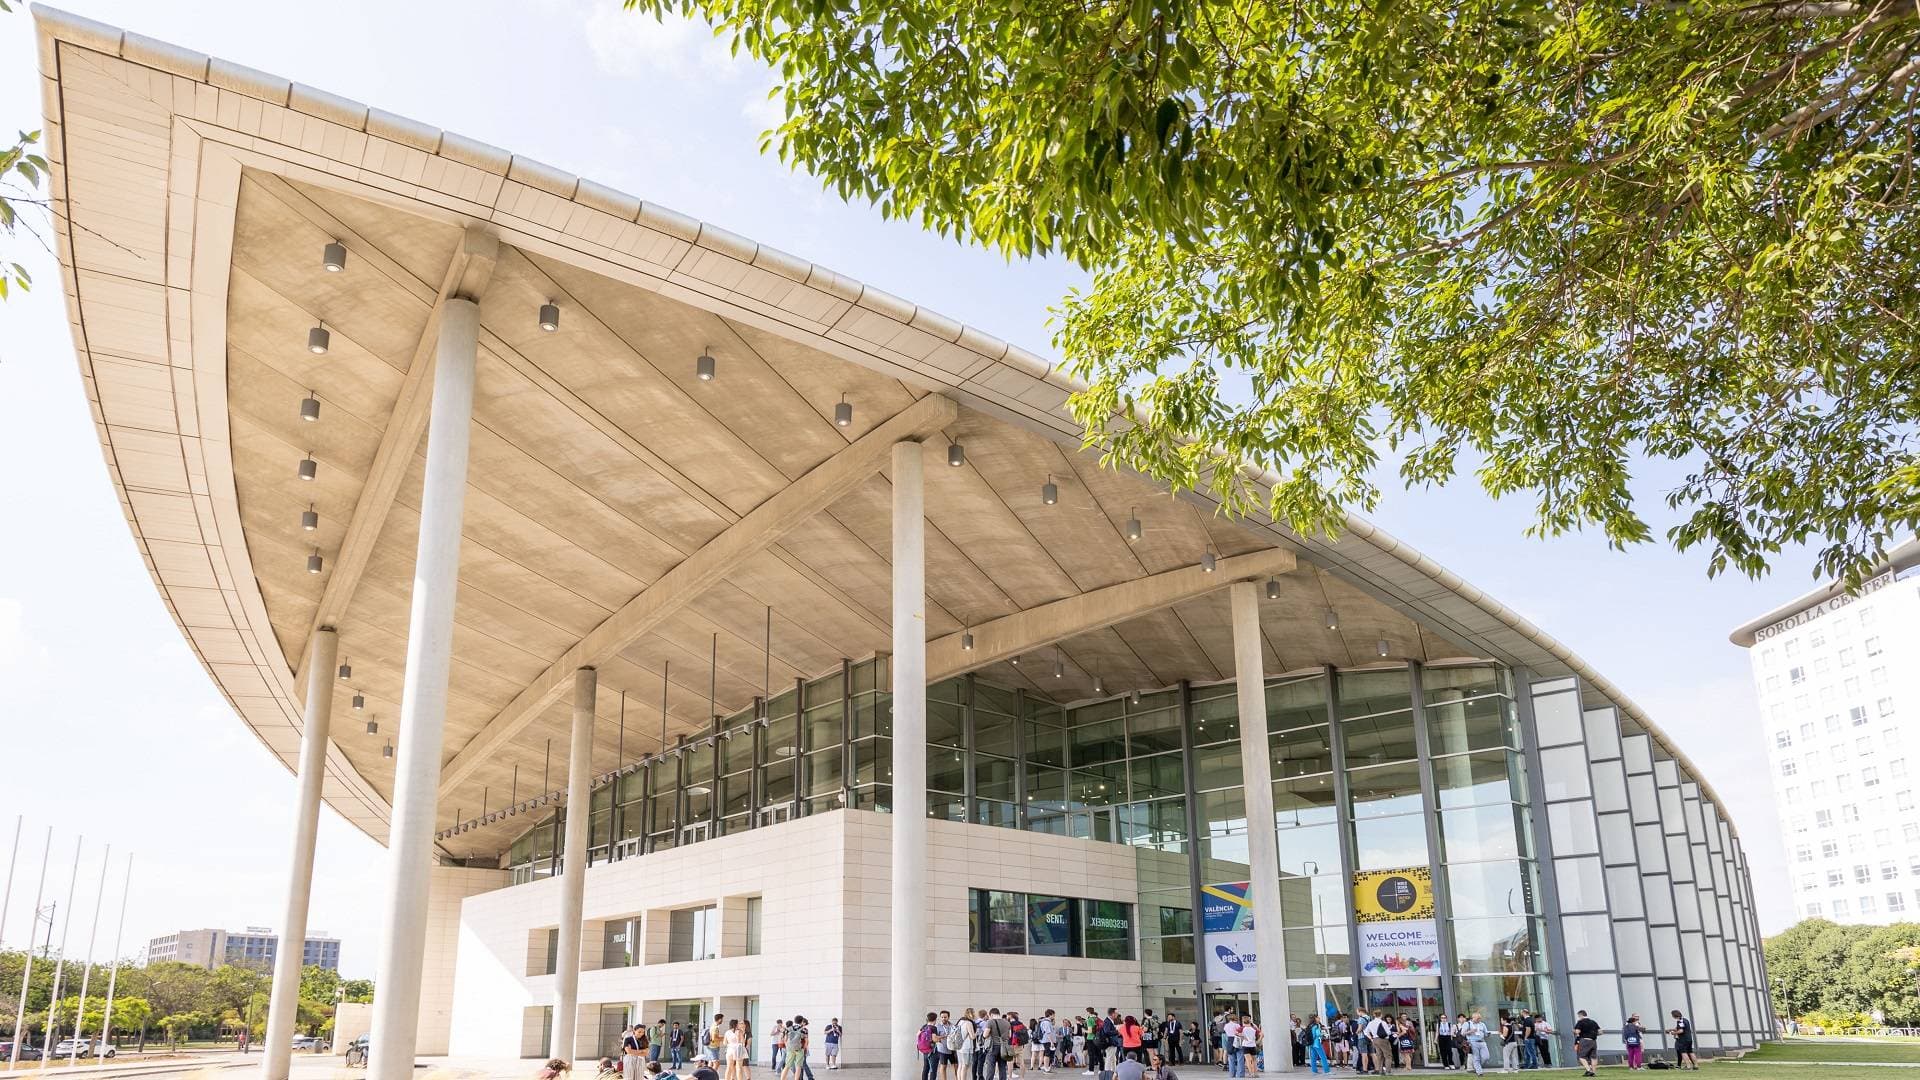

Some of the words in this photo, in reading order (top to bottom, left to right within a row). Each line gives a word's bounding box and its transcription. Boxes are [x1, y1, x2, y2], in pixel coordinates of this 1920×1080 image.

[1757, 605, 1826, 642] SOROLLA
[1366, 931, 1422, 941] WELCOME
[1222, 955, 1238, 963] eas
